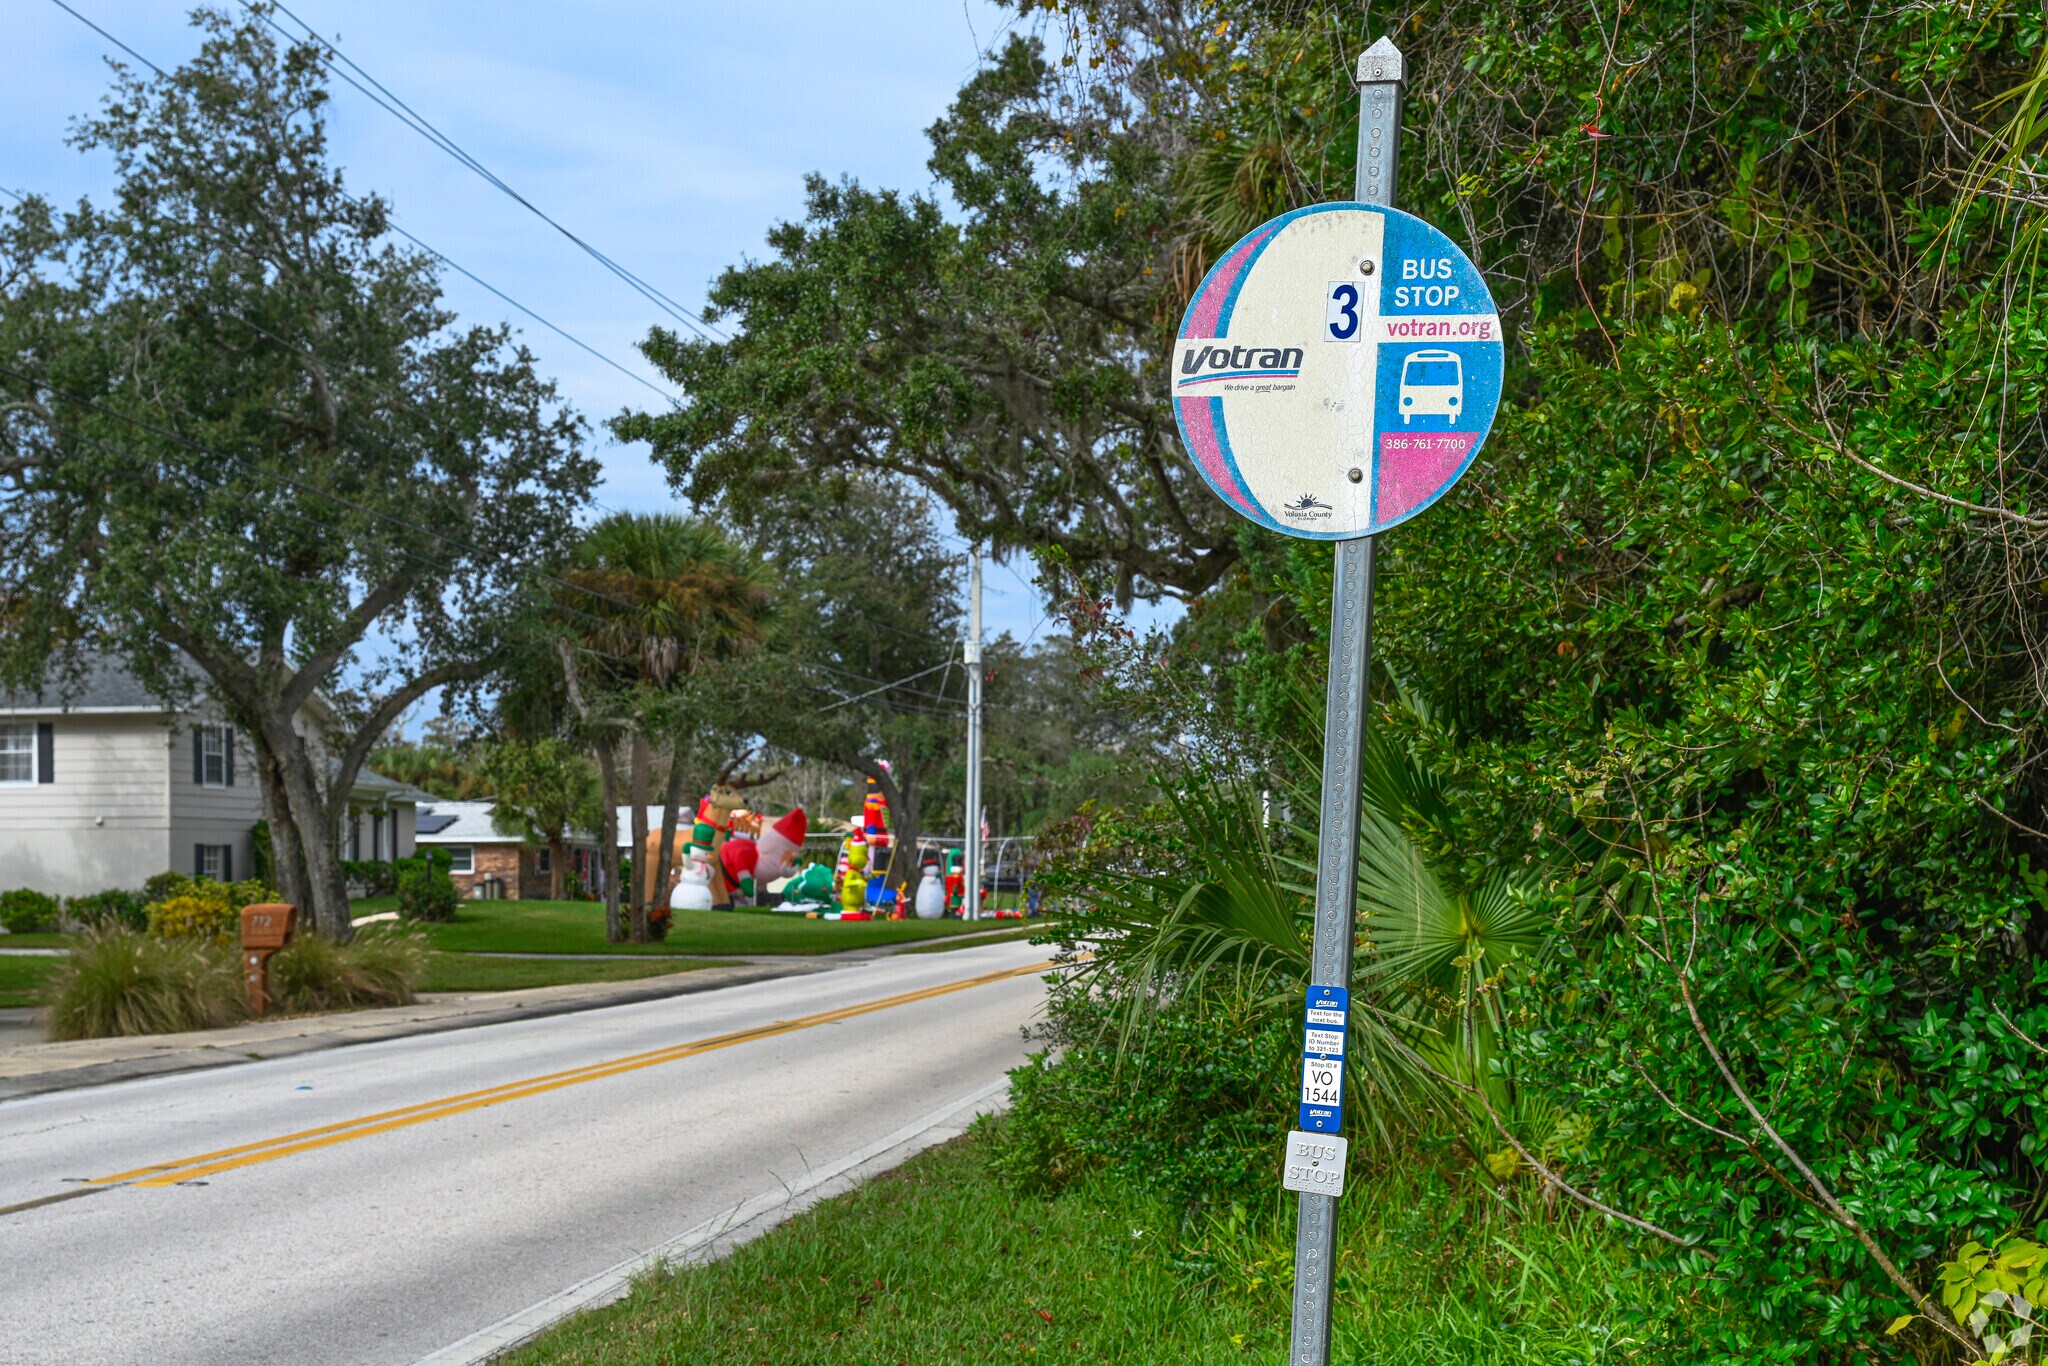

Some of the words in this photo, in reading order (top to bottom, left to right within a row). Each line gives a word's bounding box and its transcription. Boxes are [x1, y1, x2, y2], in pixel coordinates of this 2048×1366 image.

[1402, 258, 1452, 280] BUS
[1394, 286, 1460, 307] STOP
[1329, 284, 1359, 340] 3
[1387, 318, 1492, 340] votran.org
[1181, 345, 1304, 375] Votran
[1255, 384, 1271, 393] great
[1272, 384, 1296, 393] bargain
[1385, 438, 1467, 450] 386-761-7700
[1308, 511, 1333, 519] County
[1310, 1061, 1325, 1069] Stop
[1312, 1070, 1334, 1086] VO
[1305, 1087, 1338, 1104] 1544
[1295, 1142, 1337, 1161] BUS
[1288, 1165, 1341, 1185] STOP
